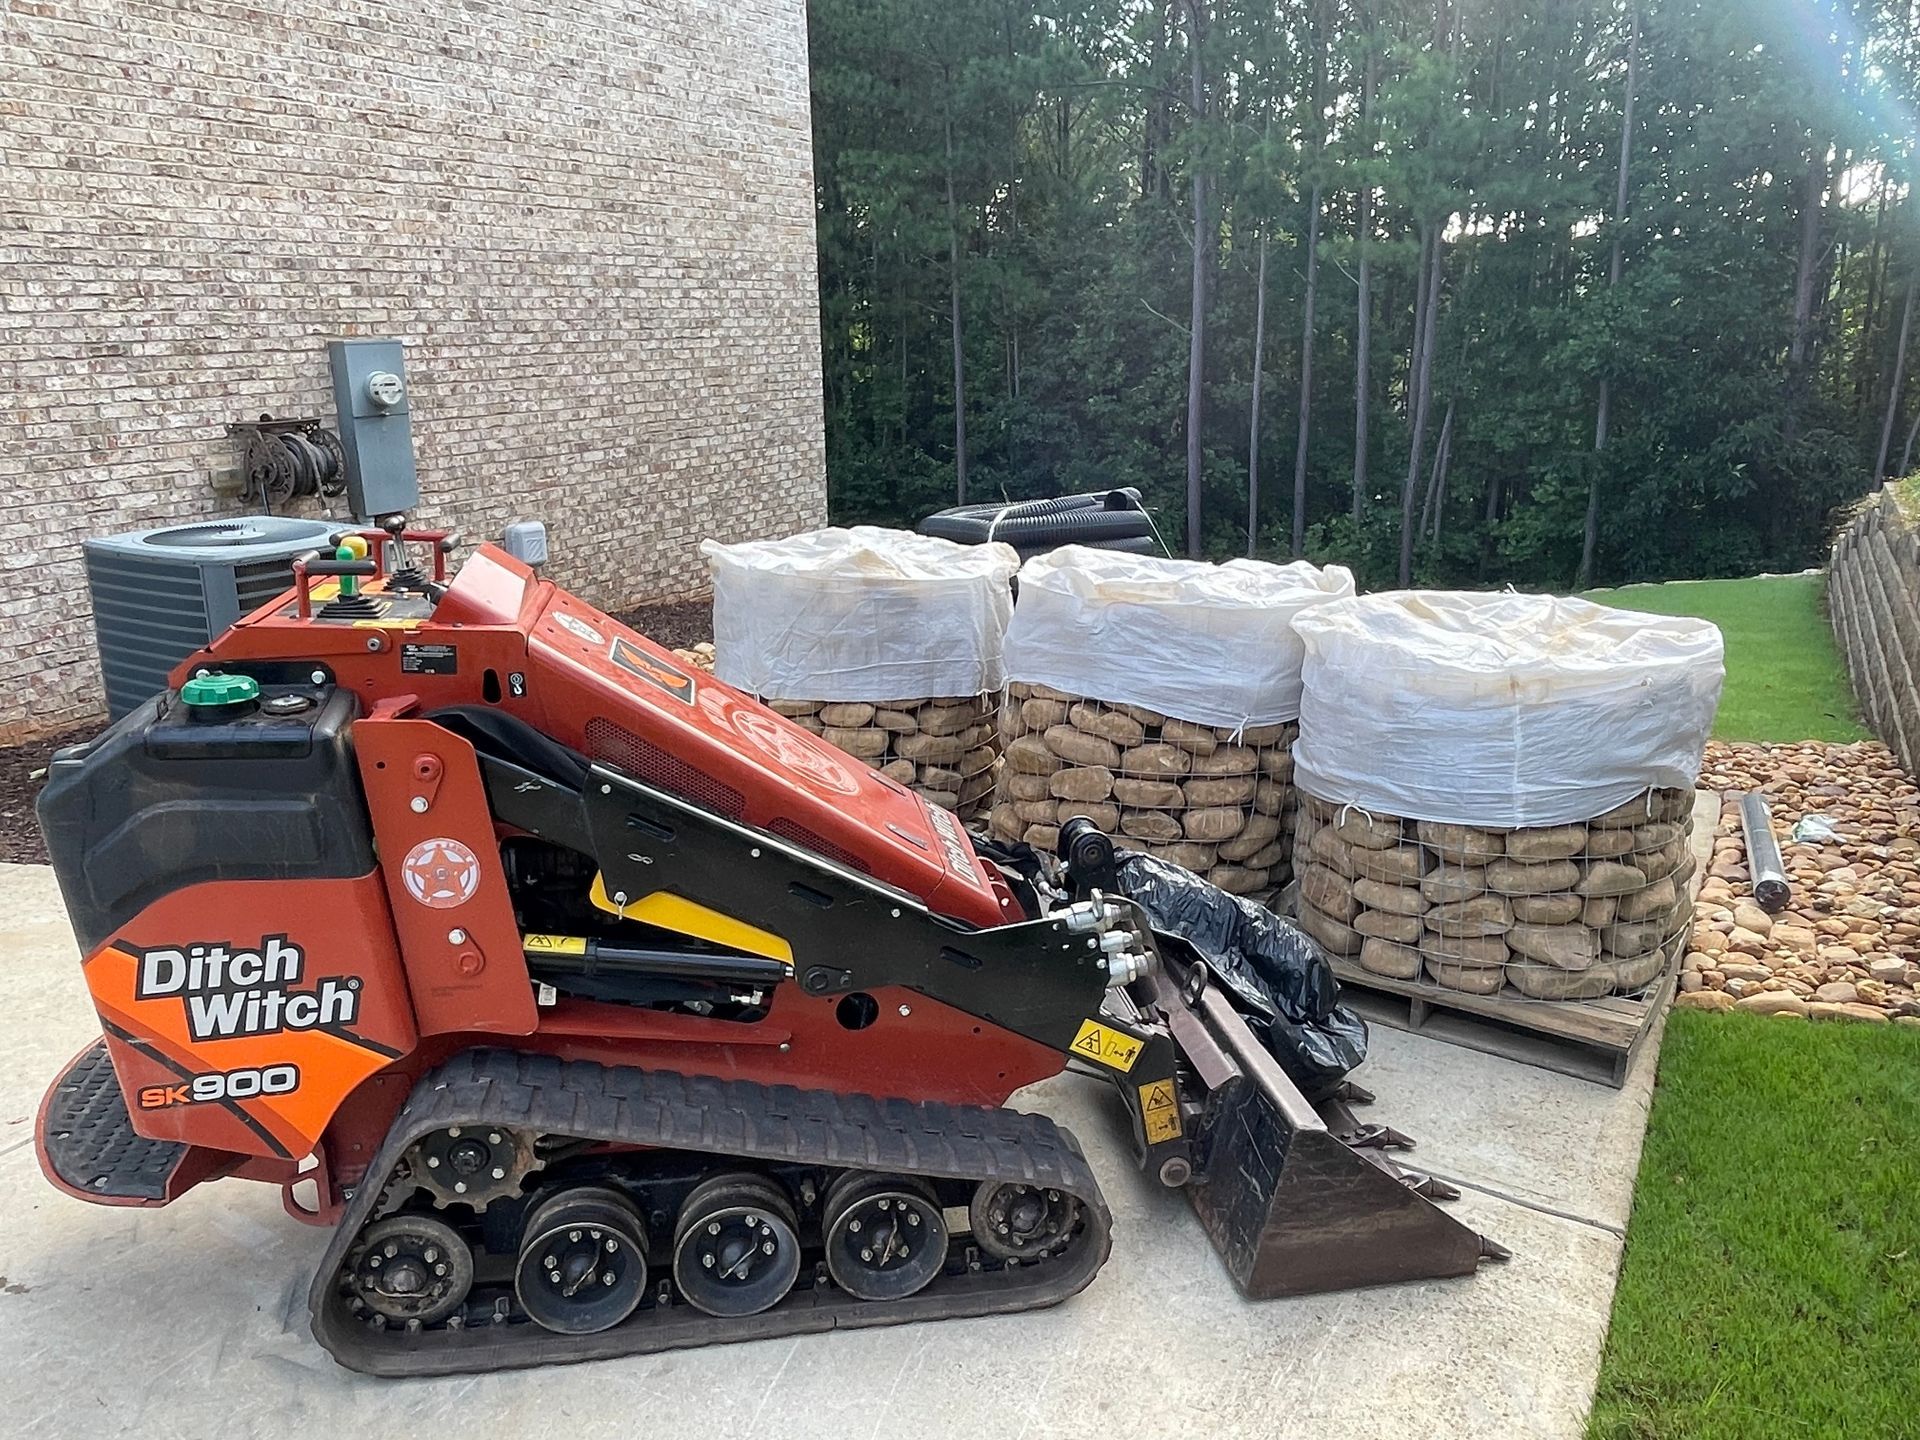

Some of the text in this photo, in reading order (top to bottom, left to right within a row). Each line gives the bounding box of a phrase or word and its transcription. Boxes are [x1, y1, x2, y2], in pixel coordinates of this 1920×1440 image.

[141, 939, 300, 996] Ditch
[189, 981, 355, 1038] Witch
[140, 1066, 297, 1108] SK900
